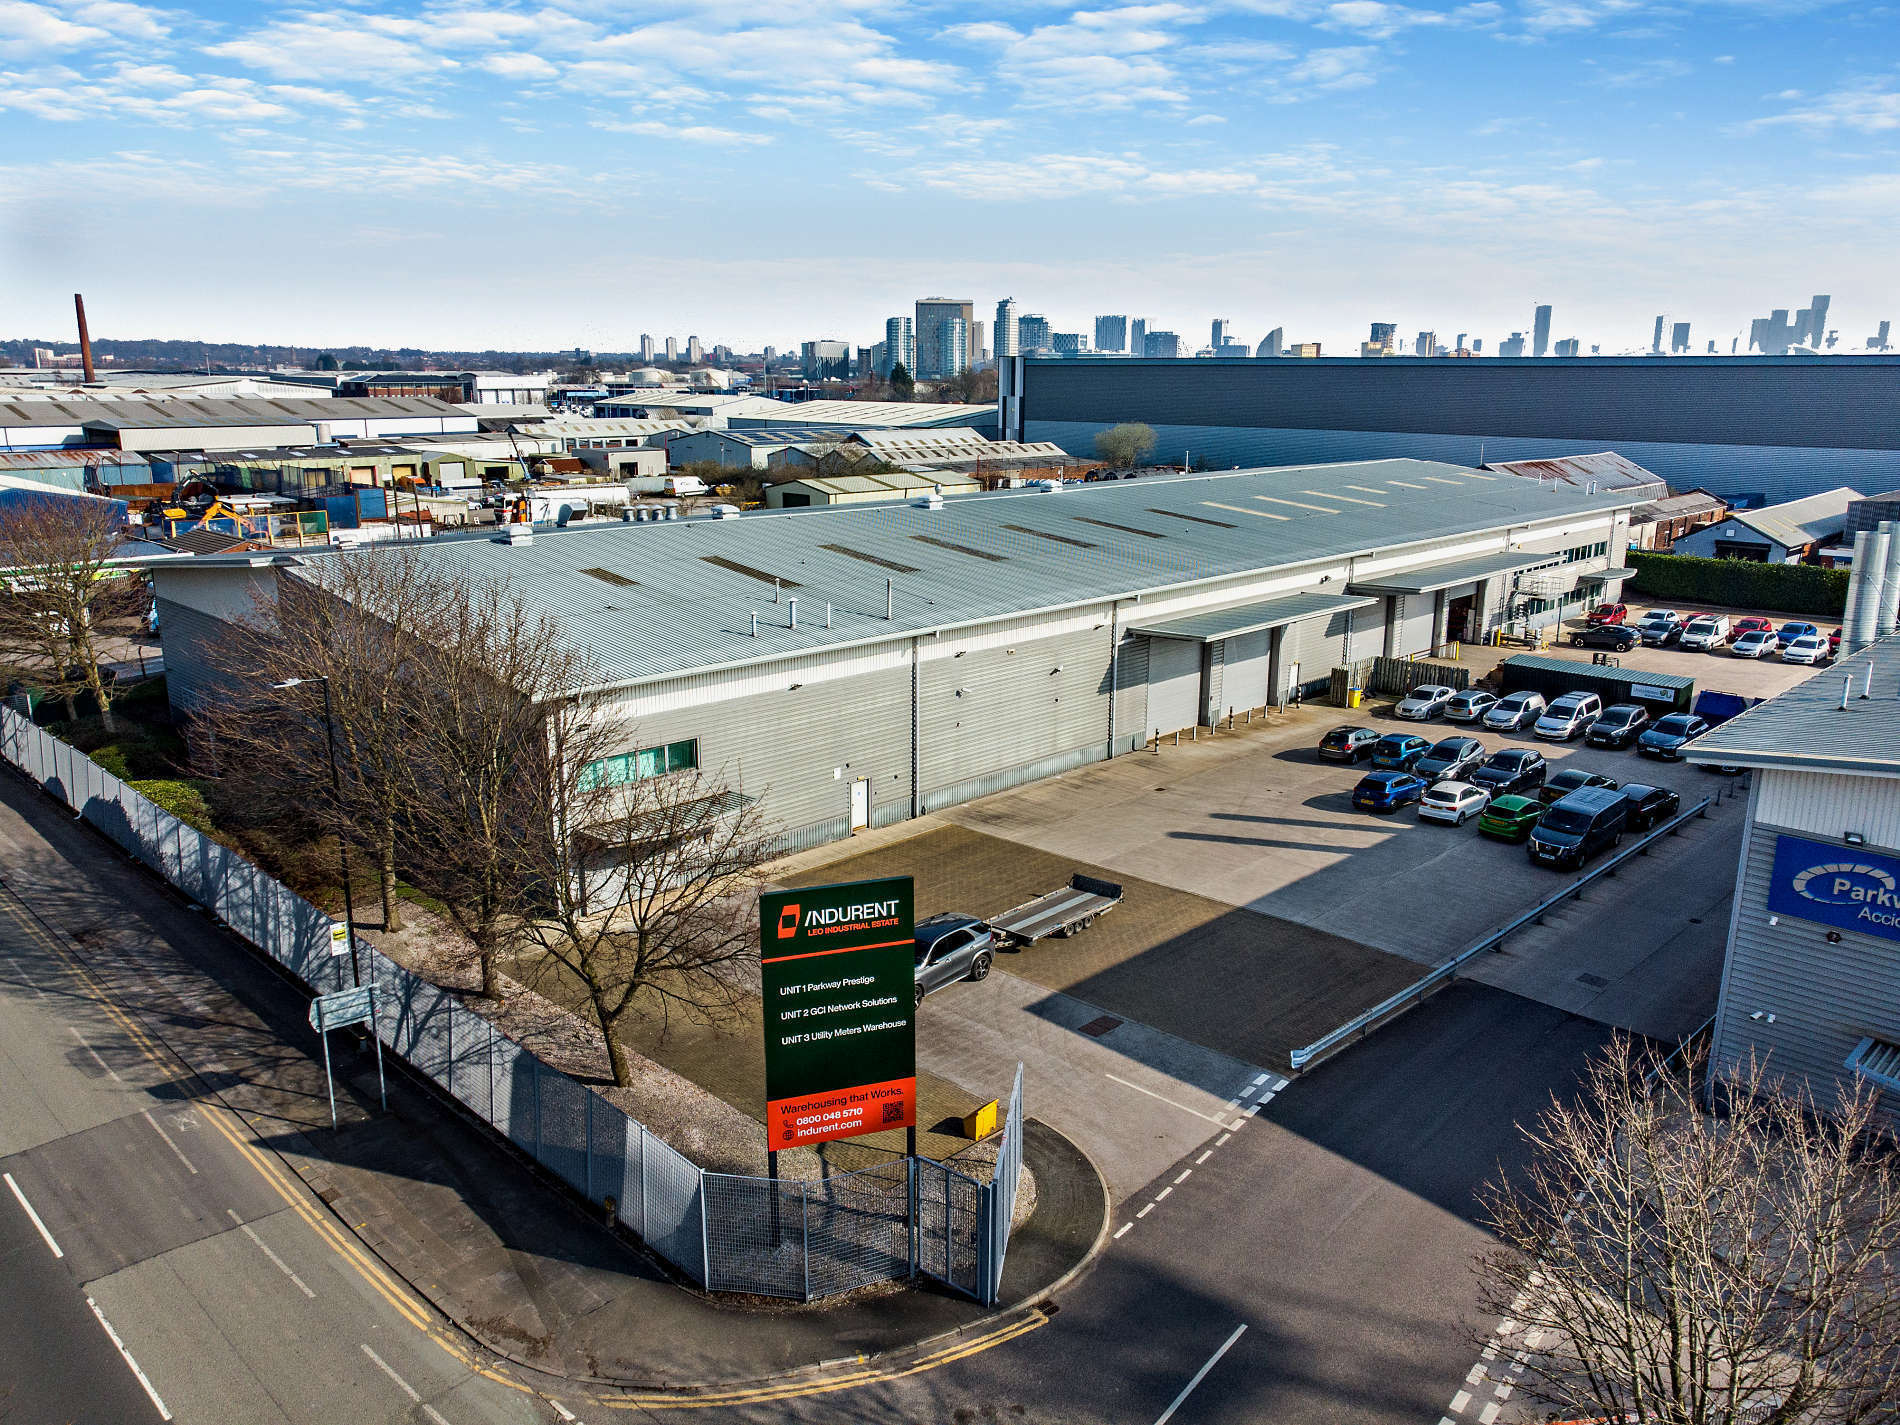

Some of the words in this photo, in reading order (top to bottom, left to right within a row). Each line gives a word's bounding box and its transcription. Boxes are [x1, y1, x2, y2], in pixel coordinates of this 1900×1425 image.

[808, 928, 824, 936] LEO
[825, 922, 870, 934] INDUSTRIAL
[872, 918, 899, 928] ESTATE
[780, 985, 801, 996] UNIT
[808, 981, 842, 992] Parkway
[842, 976, 875, 986] Prestige
[780, 1010, 802, 1020] UNIT
[803, 1009, 809, 1017] 2
[810, 1006, 826, 1016] GCI
[827, 1001, 861, 1013] Network
[862, 996, 898, 1008] Solutions
[781, 1034, 802, 1045] UNIT
[812, 1030, 833, 1040] Utility
[834, 1026, 862, 1037] Meters
[862, 1020, 906, 1032] Warehouse
[780, 1096, 847, 1114] Warehousing
[850, 1092, 868, 1102] that
[871, 1088, 904, 1099] Works.
[796, 1115, 821, 1126] 0800
[823, 1111, 841, 1121] 048
[843, 1107, 863, 1117] 5710
[797, 1120, 862, 1137] indurent.com
